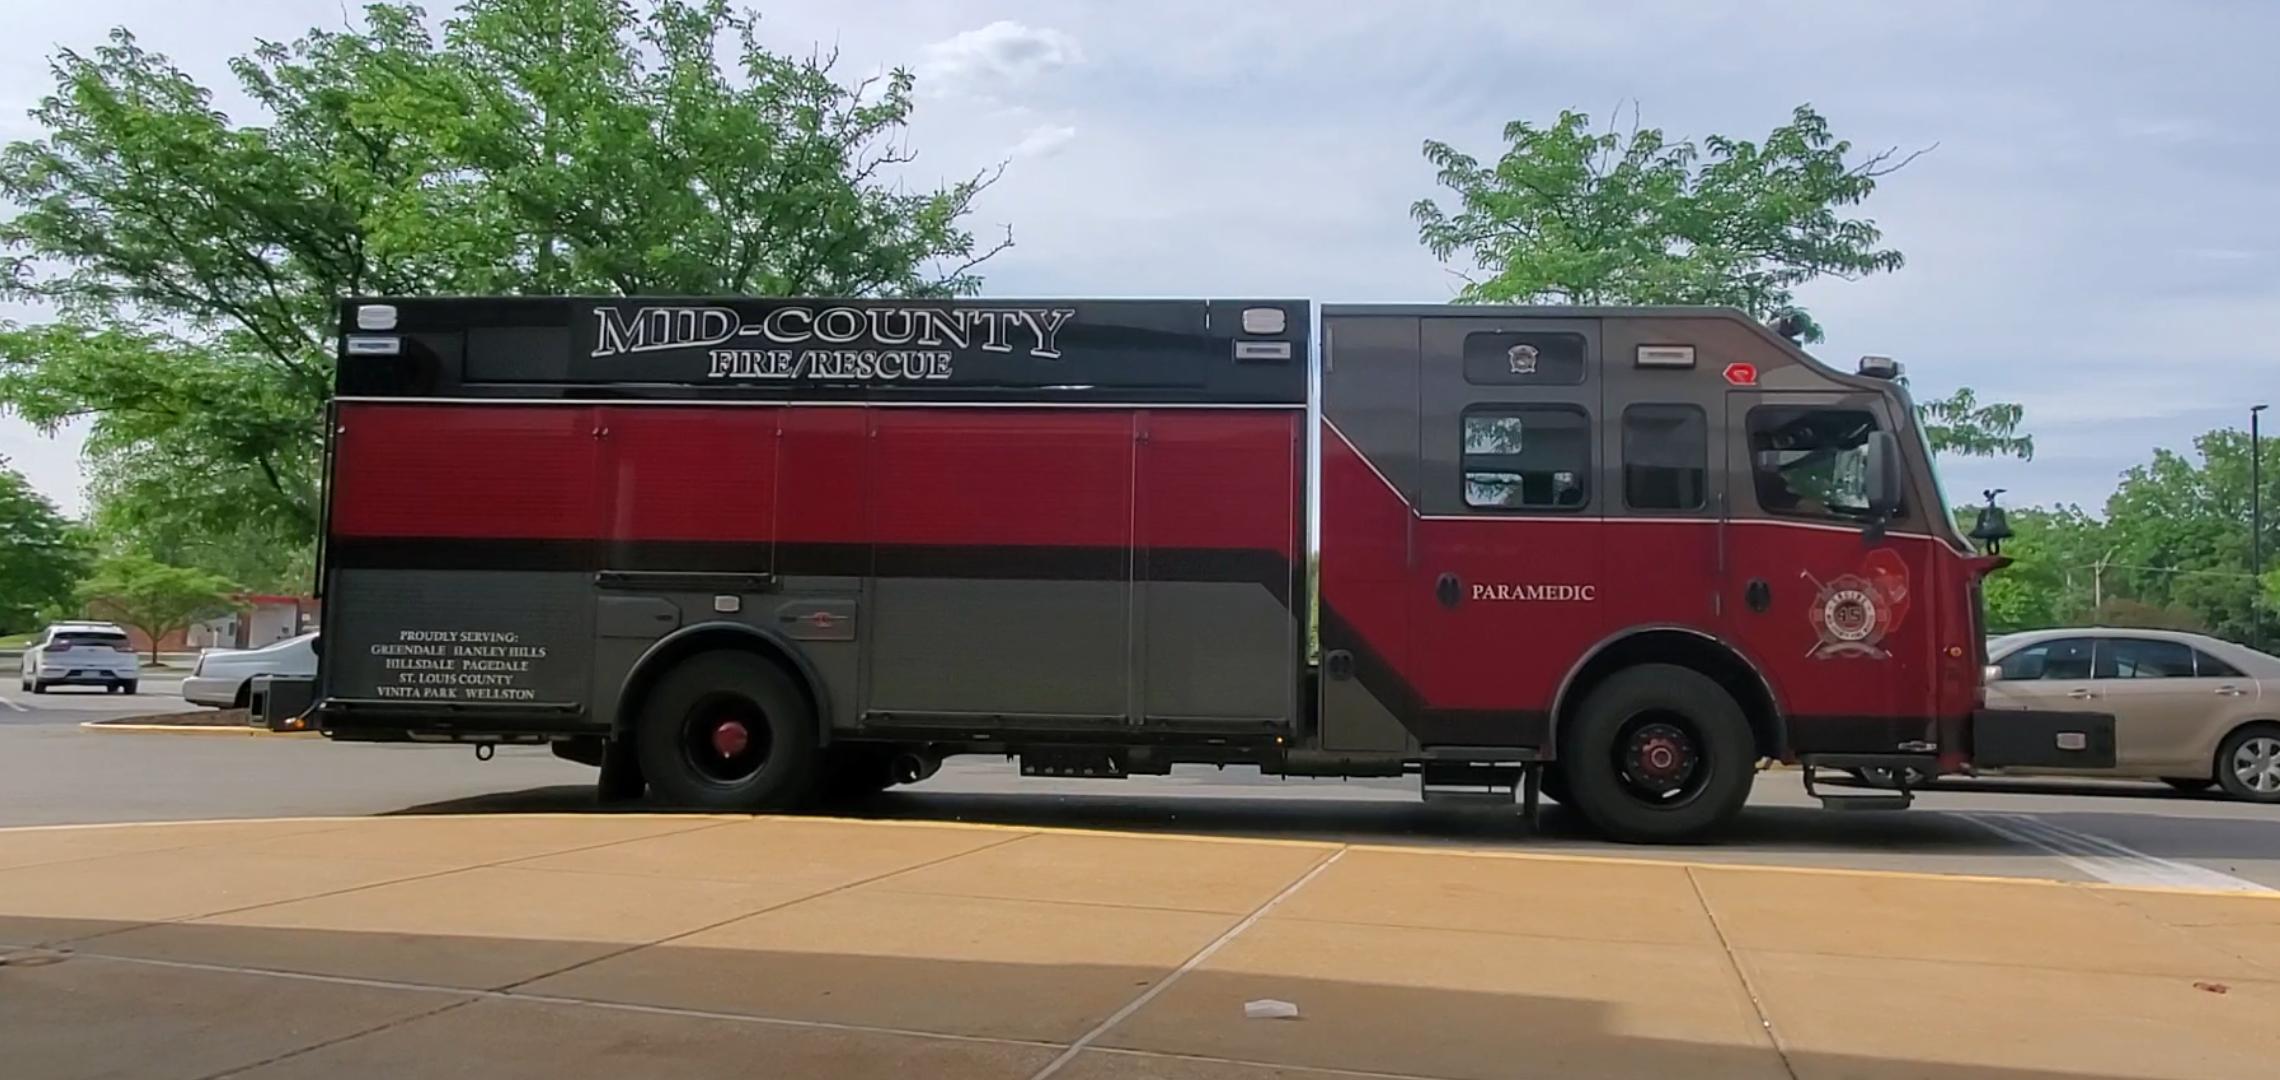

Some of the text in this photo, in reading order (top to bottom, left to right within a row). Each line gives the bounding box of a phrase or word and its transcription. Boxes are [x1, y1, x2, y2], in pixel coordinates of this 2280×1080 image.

[592, 306, 1075, 359] MID-COUNTY
[707, 349, 953, 380] FIRE/RESCUE
[1472, 584, 1596, 601] PARAMEDIC
[400, 630, 519, 643] PROUDLY SERVING:
[371, 644, 547, 658] GREENDALE HANLEY HILLS
[386, 658, 529, 672] HILLSDALE PAGEDALE
[399, 673, 513, 685] ST. LOUIS COUNTY
[377, 686, 535, 700] VINITA PARK WELLSTON
